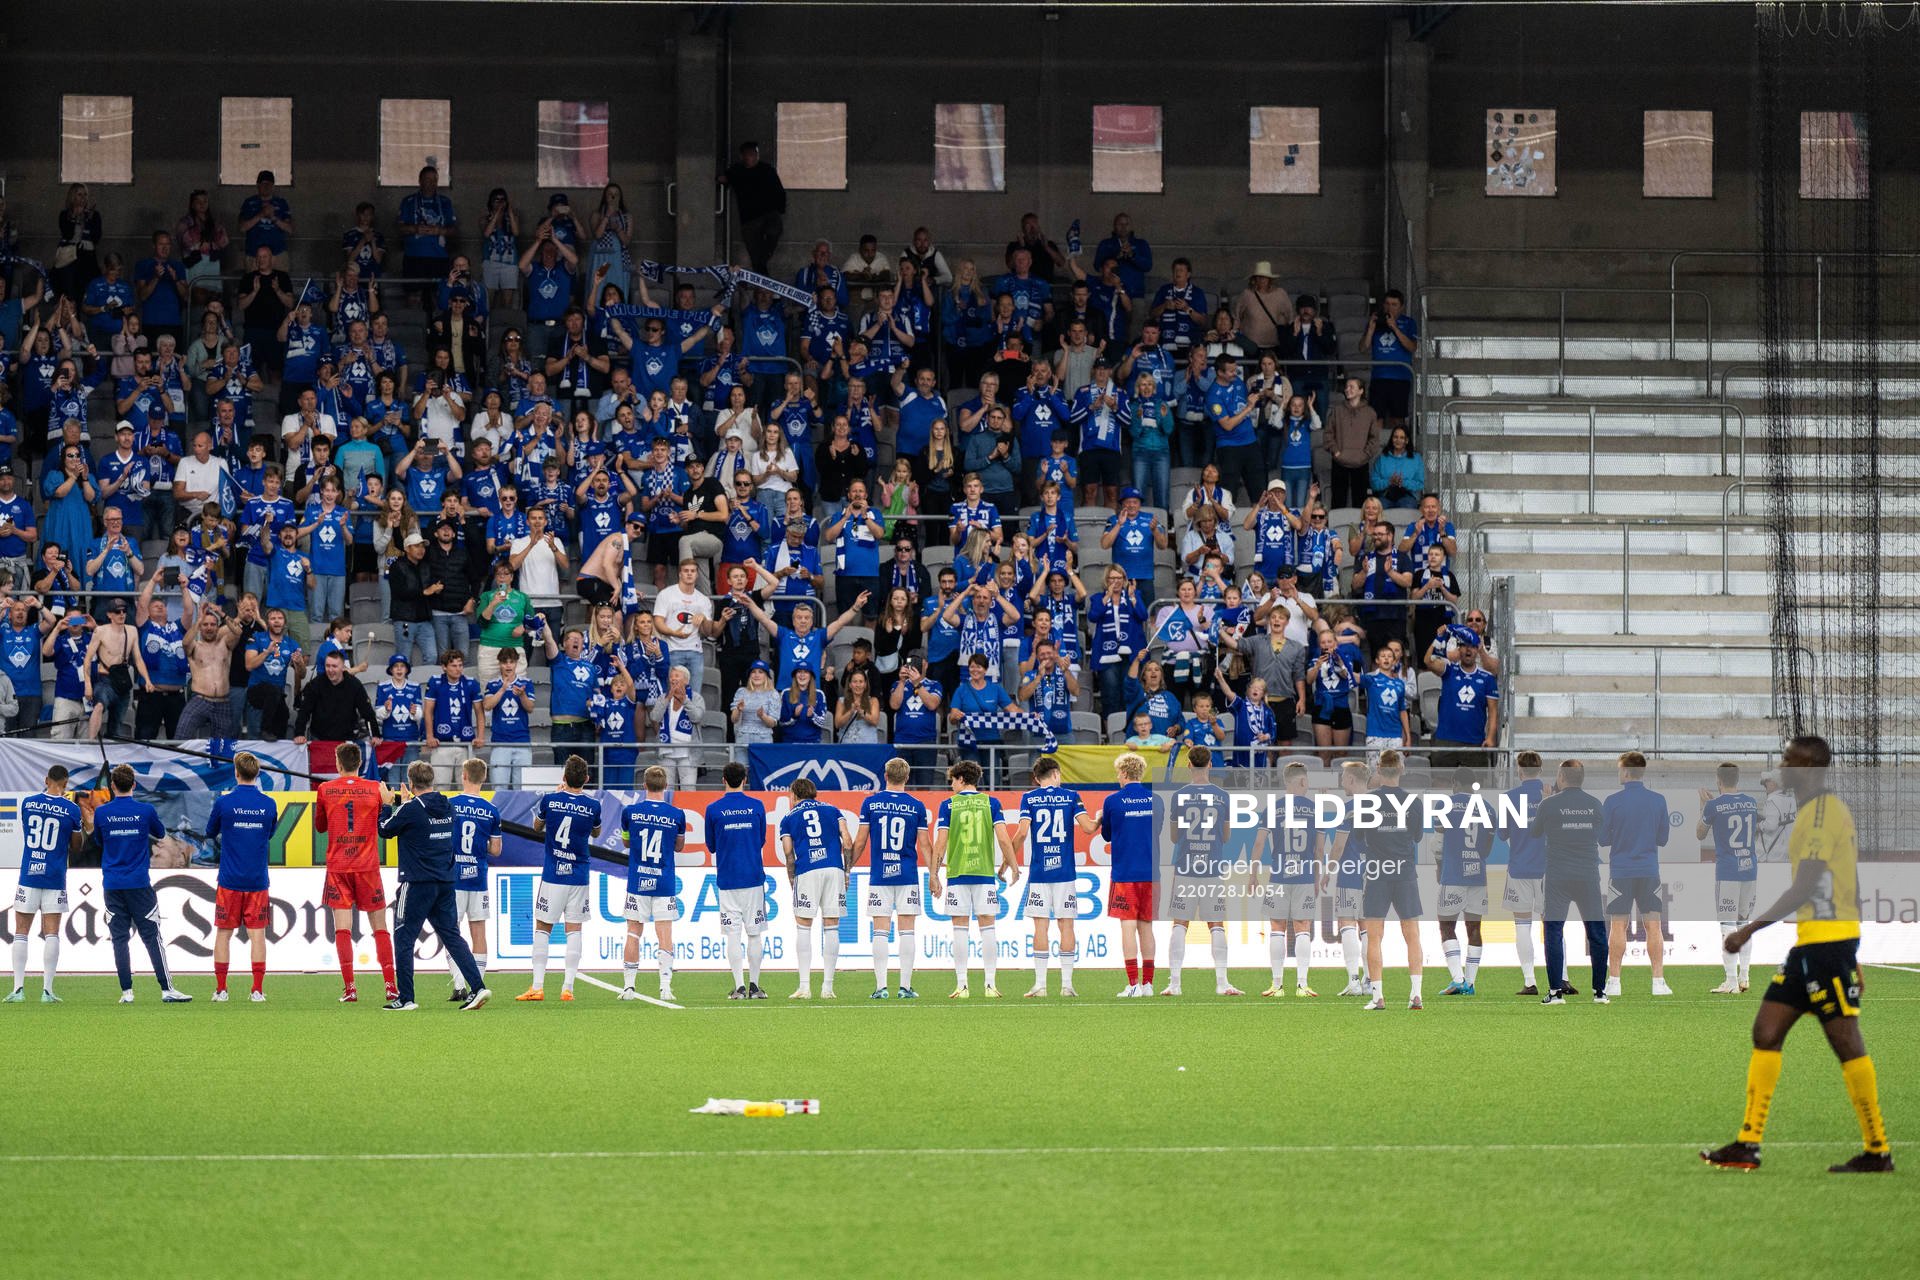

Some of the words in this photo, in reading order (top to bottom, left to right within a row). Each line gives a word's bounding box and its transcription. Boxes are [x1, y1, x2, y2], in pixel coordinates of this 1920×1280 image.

[1027, 795, 1072, 805] BRUNVOLL
[233, 807, 259, 815] Vikenco
[454, 805, 494, 819] RUNVOLL
[548, 801, 594, 815] BRUNVOLL
[721, 809, 747, 817] Vikenco
[869, 801, 917, 814] BRUNVOLL
[1560, 808, 1588, 816] Vikenco
[344, 800, 354, 832] 1
[428, 817, 448, 825] Vikenco
[631, 813, 677, 826] BRUNVOLL
[1185, 806, 1218, 840] 22
[803, 810, 822, 837] 3
[960, 810, 983, 844] 31
[1036, 808, 1067, 843] 24
[1464, 811, 1479, 849] 9
[27, 815, 60, 851] 30
[461, 820, 476, 854] 8
[554, 815, 573, 849] 4
[878, 815, 906, 851] 19
[1280, 818, 1308, 852] 15
[1728, 813, 1753, 849] 21
[639, 828, 663, 863] 14
[1043, 845, 1061, 854] BAKKE
[31, 863, 46, 871] MOT
[1046, 855, 1062, 866] MOT
[1466, 862, 1480, 872] MOT
[463, 865, 478, 875] MOT
[885, 863, 901, 873] MOT
[640, 878, 657, 887] MOT
[1719, 905, 1737, 913] BYGG
[600, 936, 694, 960] Ulrihans
[762, 936, 784, 960] AB
[1086, 934, 1107, 958] AB
